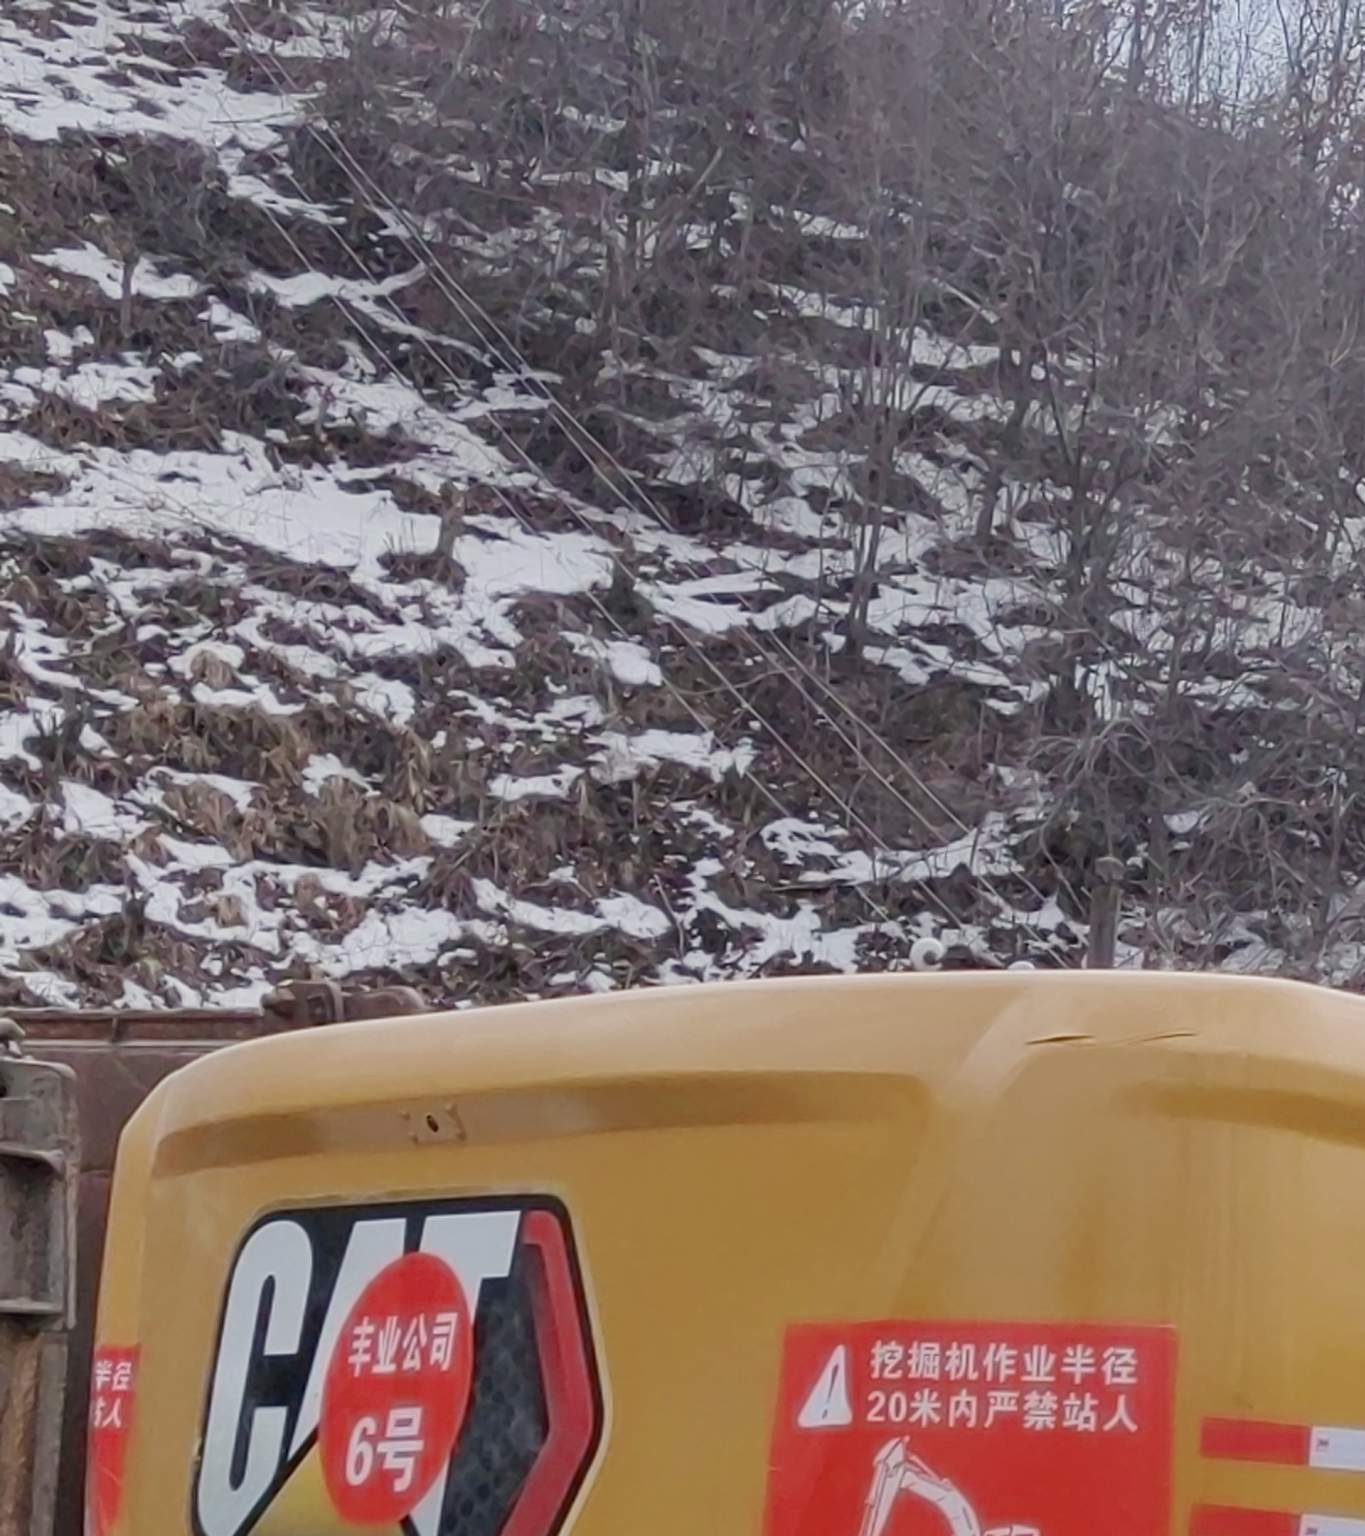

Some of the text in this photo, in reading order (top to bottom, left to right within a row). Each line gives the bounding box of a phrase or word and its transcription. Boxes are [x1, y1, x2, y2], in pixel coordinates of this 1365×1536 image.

[348, 1311, 458, 1376] 丰业公司
[870, 1339, 1139, 1386] 挖掘机作业半径
[865, 1390, 1139, 1432] 20米内严禁站人
[345, 1406, 425, 1493] 6号
